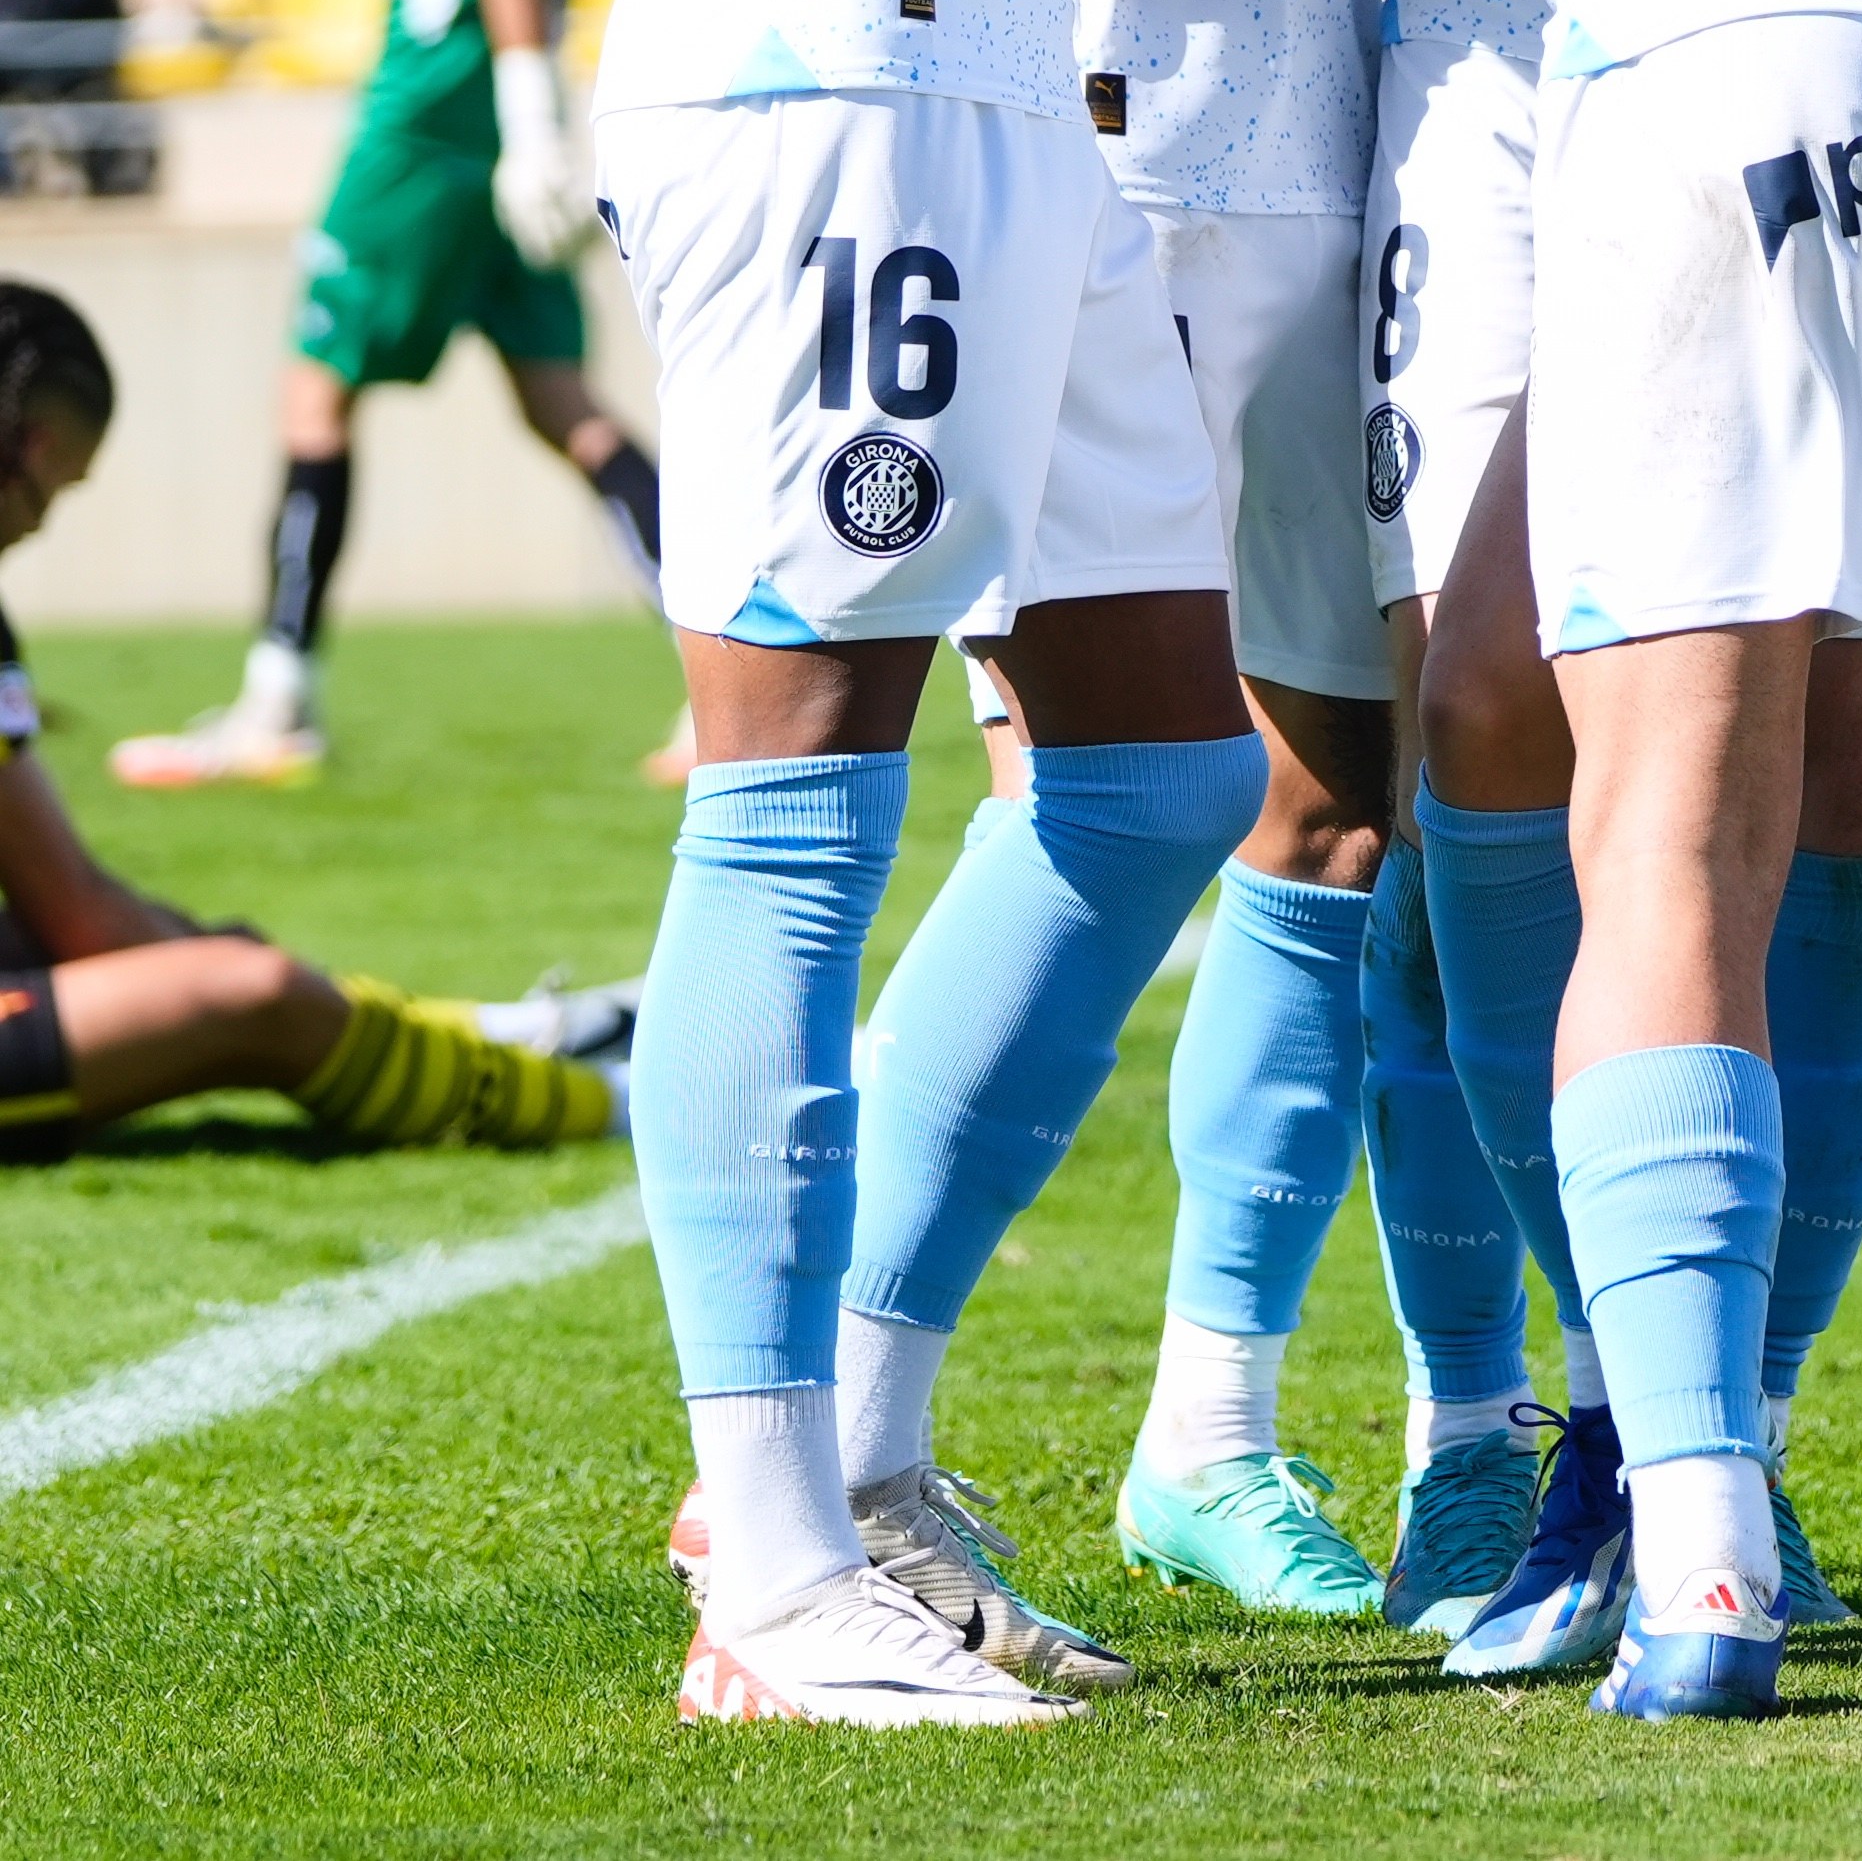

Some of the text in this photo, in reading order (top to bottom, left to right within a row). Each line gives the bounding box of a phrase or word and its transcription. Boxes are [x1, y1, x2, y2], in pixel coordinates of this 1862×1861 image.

[1374, 223, 1430, 384] 8
[800, 236, 960, 420] 16
[845, 443, 919, 474] GIRONA
[843, 523, 916, 546] FUTBOL CLUB
[1389, 1222, 1501, 1248] GIRONA
